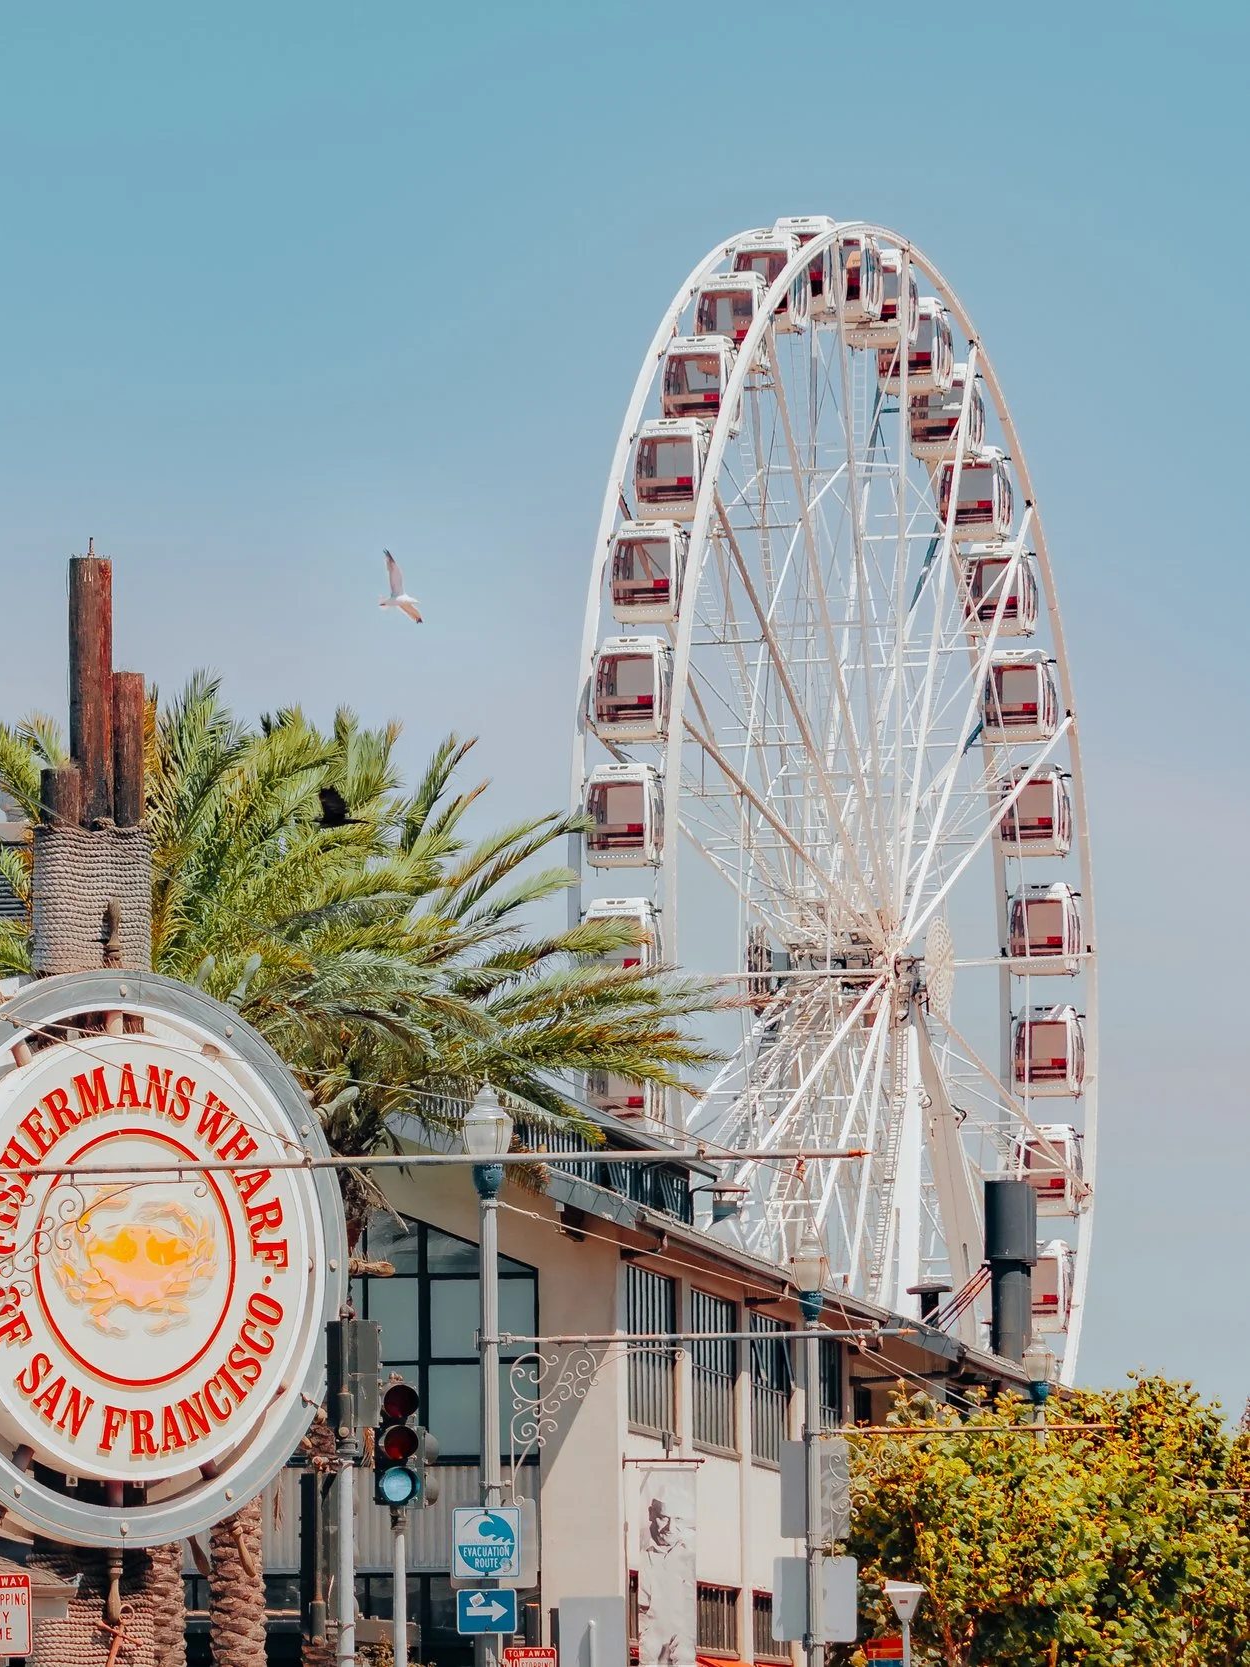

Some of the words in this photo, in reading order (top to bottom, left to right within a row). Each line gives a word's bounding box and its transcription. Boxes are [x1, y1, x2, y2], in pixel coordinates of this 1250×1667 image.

[195, 1091, 290, 1270] WHARF
[15, 1352, 95, 1438] SAN
[98, 1291, 285, 1456] FRANCISCO
[463, 1546, 510, 1557] EVACUATION
[474, 1558, 499, 1568] ROUTE
[508, 1650, 552, 1658] TOW-AWAY
